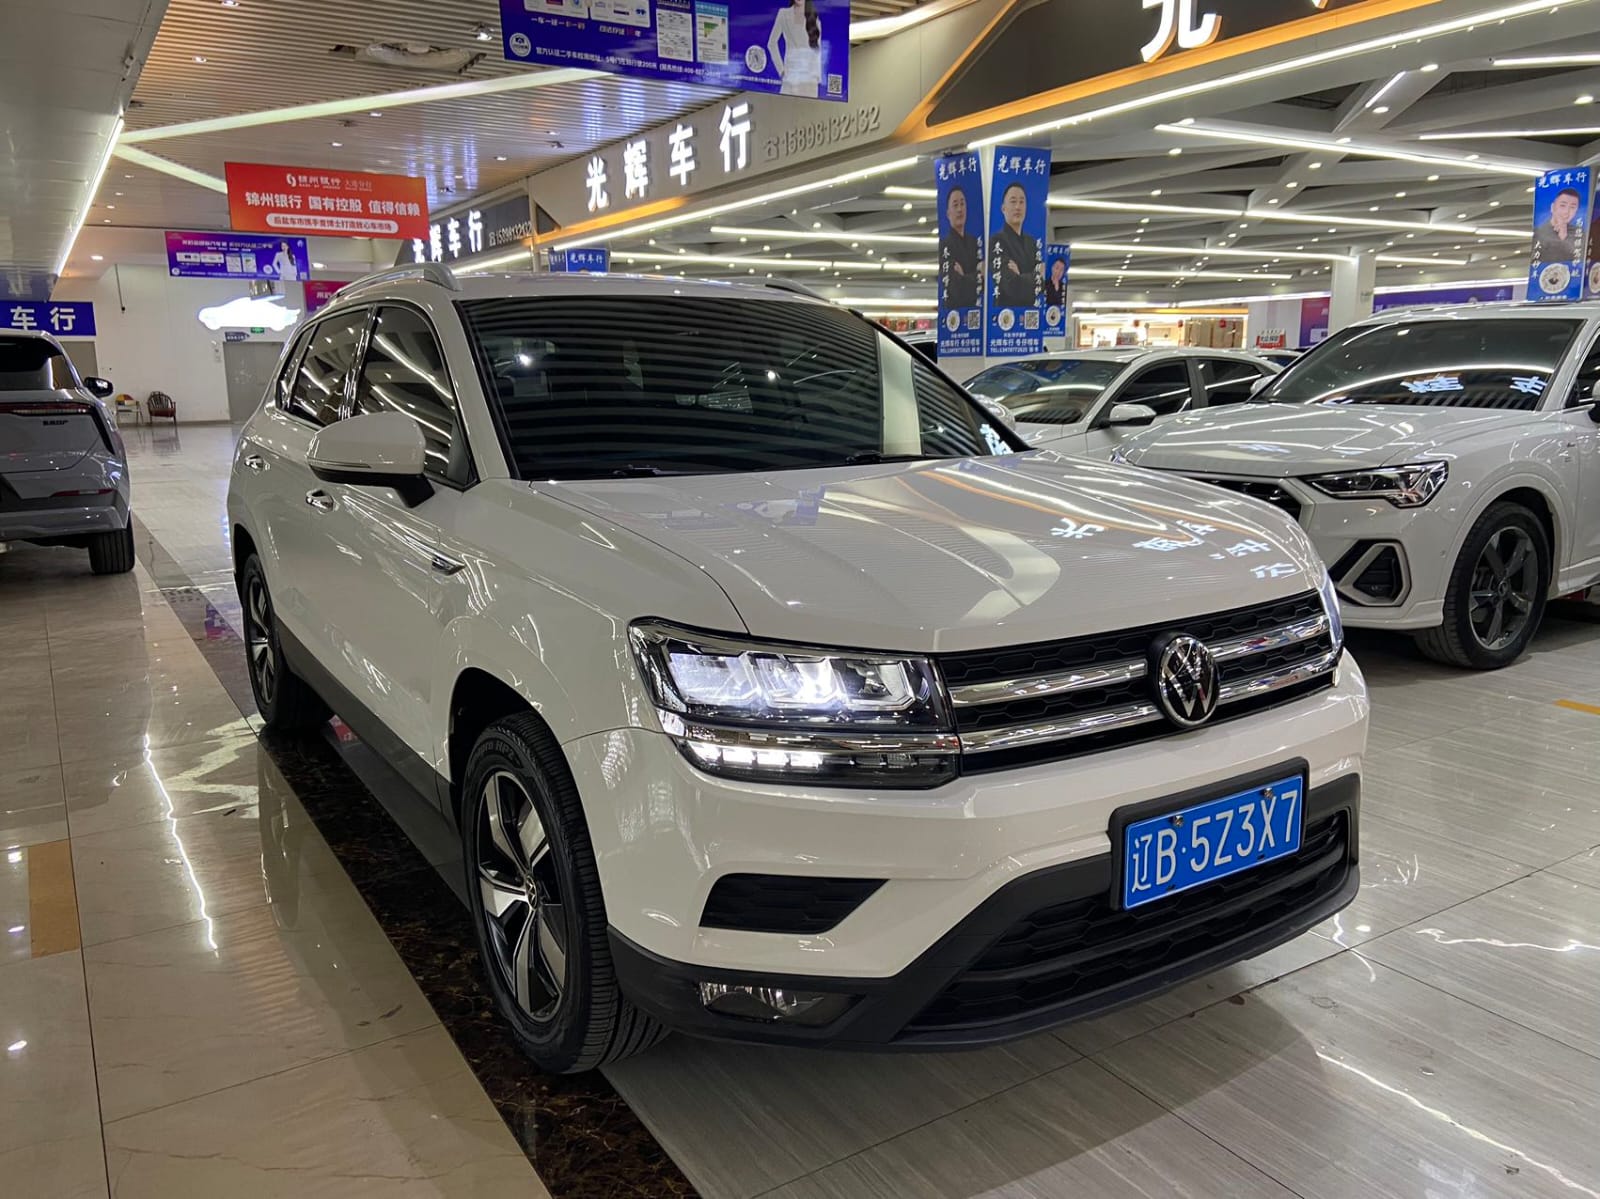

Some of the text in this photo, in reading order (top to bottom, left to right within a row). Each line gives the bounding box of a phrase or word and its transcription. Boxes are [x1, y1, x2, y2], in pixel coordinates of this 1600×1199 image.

[586, 101, 881, 212] 光辉车行 15898132132
[938, 156, 978, 181] 光辉车行
[998, 154, 1047, 176] 光辉车行
[1537, 171, 1588, 189] 光辉车行
[245, 191, 421, 217] 锦州银行 国有控股 值得信赖
[569, 252, 604, 265] 光辉车行
[10, 305, 76, 331] 车行
